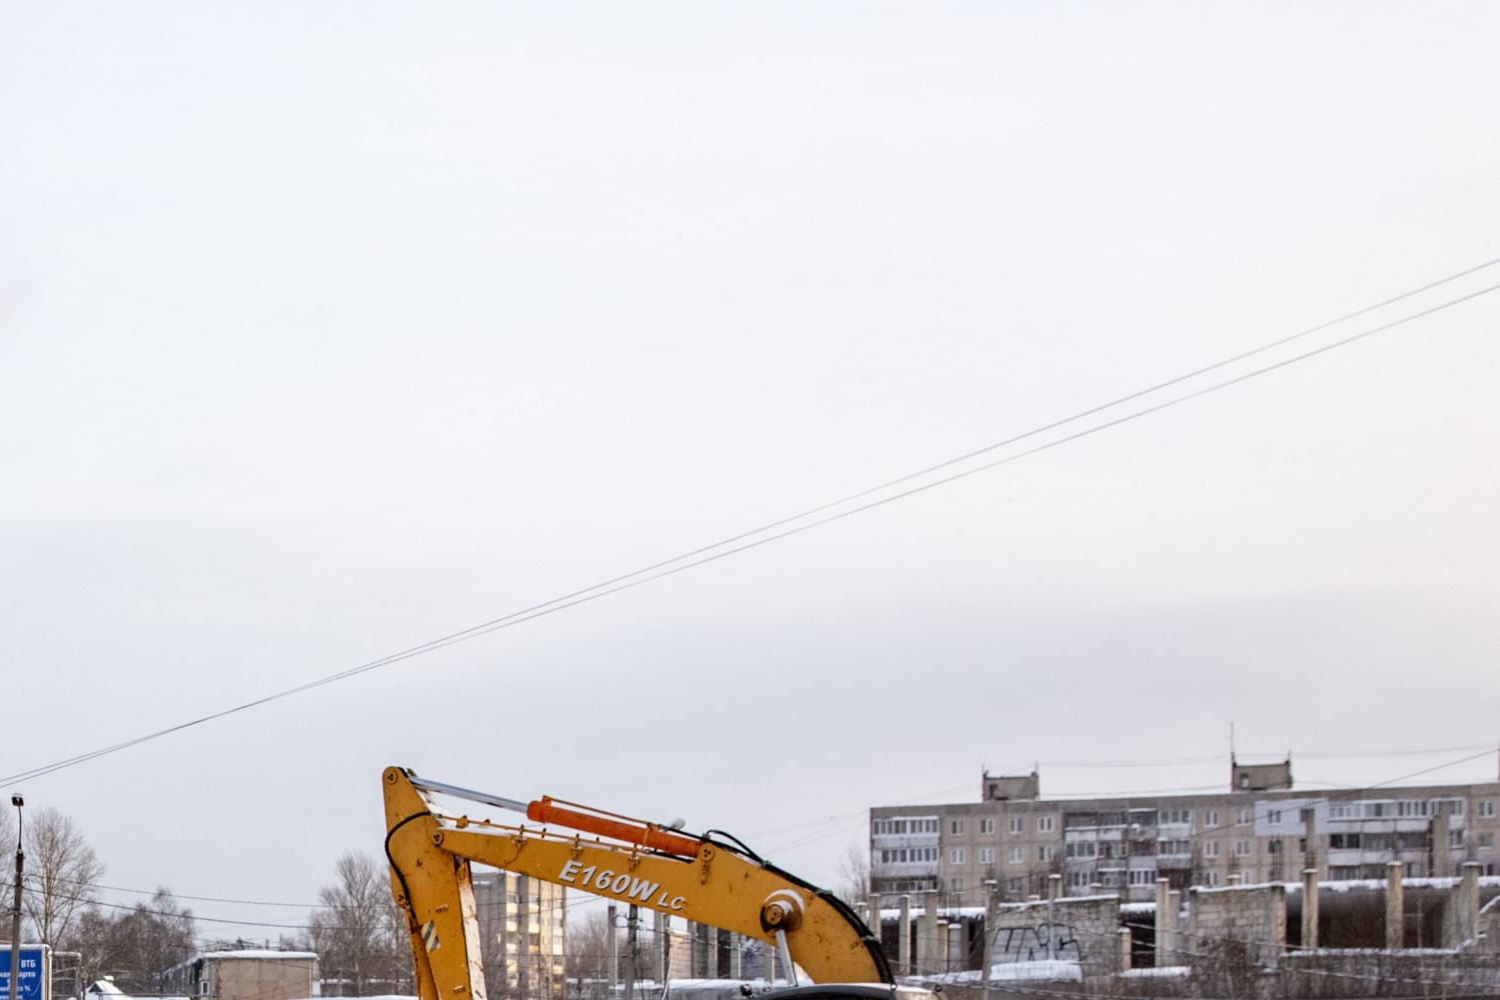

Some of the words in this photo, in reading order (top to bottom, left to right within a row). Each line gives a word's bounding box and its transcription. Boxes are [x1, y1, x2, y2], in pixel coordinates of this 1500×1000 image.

[558, 860, 661, 902] E160W
[657, 892, 686, 910] LC
[21, 960, 36, 968] ВТБ
